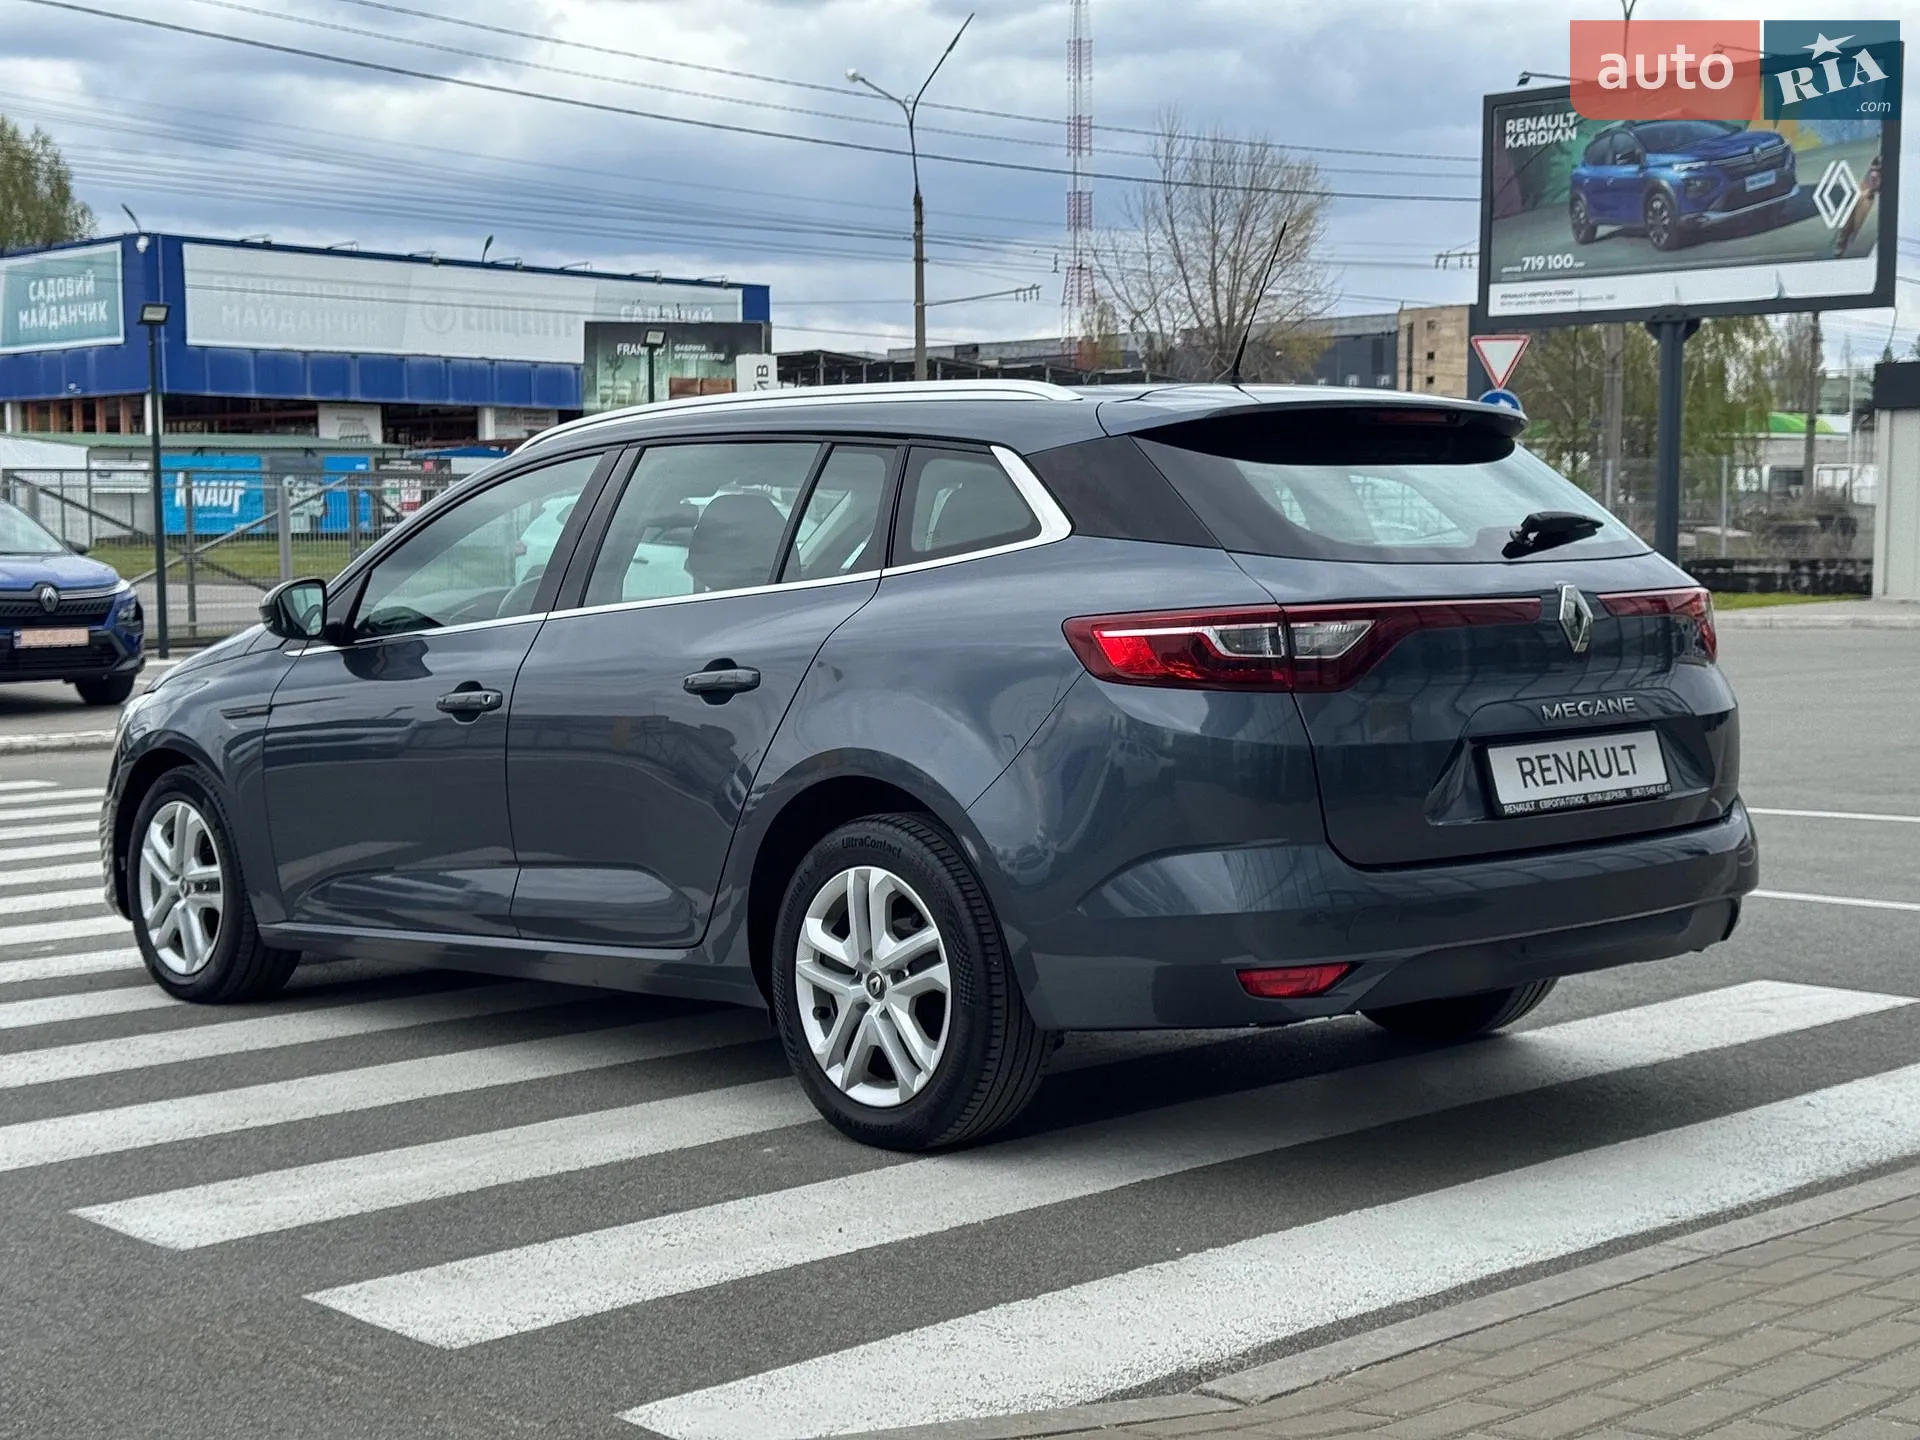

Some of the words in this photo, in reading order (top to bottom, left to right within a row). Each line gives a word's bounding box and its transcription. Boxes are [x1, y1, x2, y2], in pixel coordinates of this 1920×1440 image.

[1505, 111, 1578, 134] RENAULT
[1505, 126, 1577, 149] KARDIAN
[1521, 255, 1545, 272] 719
[1547, 253, 1575, 270] 100
[28, 269, 95, 302] САДОВИЙ
[18, 300, 108, 330] МАЙДАНЧИК
[1541, 697, 1637, 720] MEGANE
[1516, 744, 1637, 789] RENAULT
[841, 835, 902, 859] UltraContact
